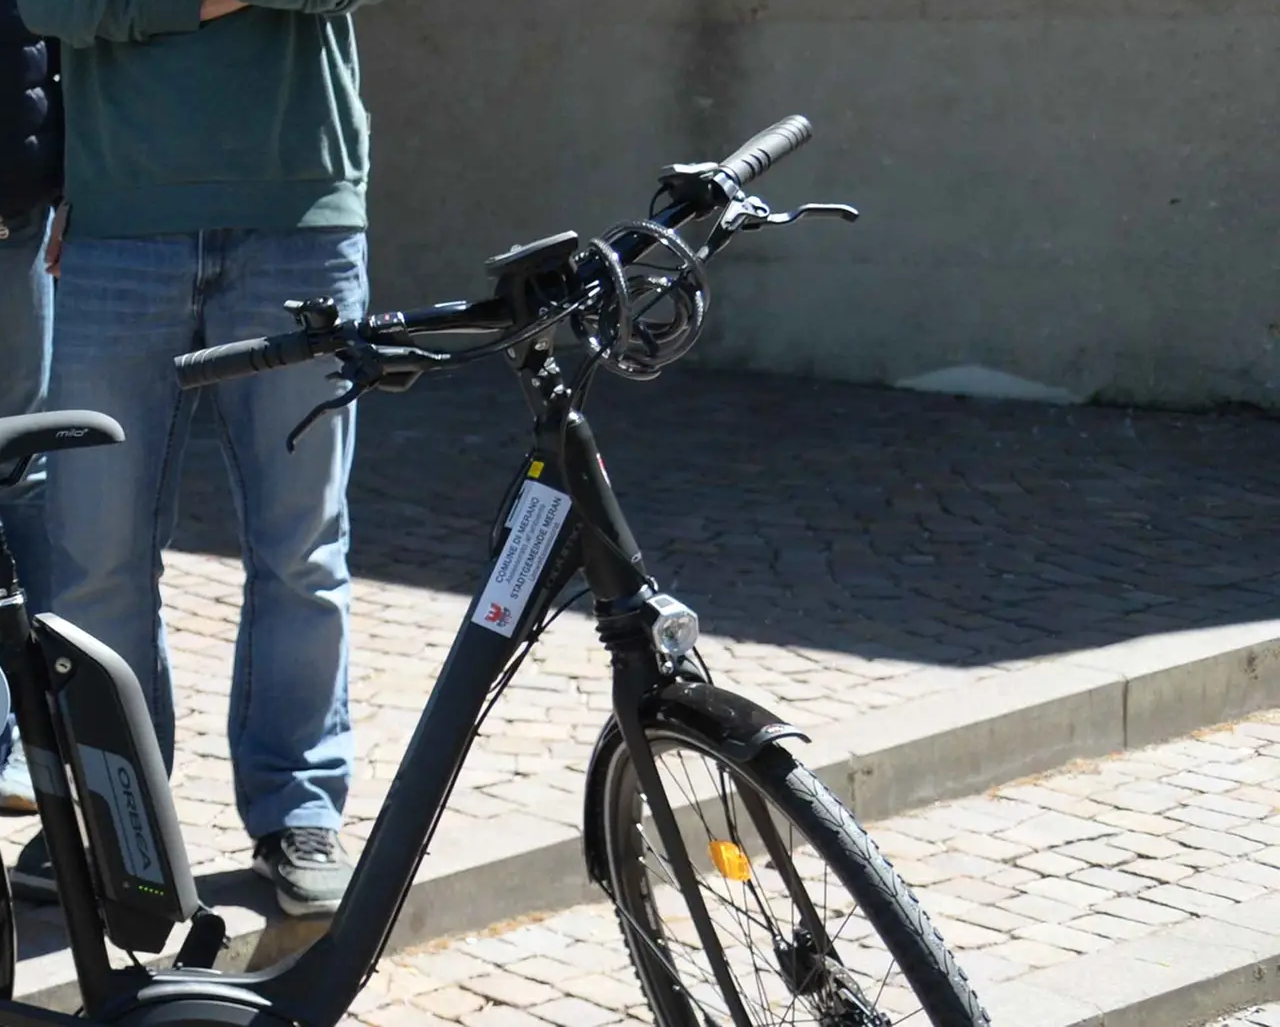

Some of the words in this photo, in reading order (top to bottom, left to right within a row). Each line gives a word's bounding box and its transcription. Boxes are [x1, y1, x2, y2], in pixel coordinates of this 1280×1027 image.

[518, 496, 541, 536] MERANO
[510, 529, 548, 600] STADTGEMEINDE
[541, 496, 563, 532] MERAN
[513, 533, 525, 546] DI
[495, 543, 518, 584] COMUNE
[117, 765, 152, 873] ORBEA
